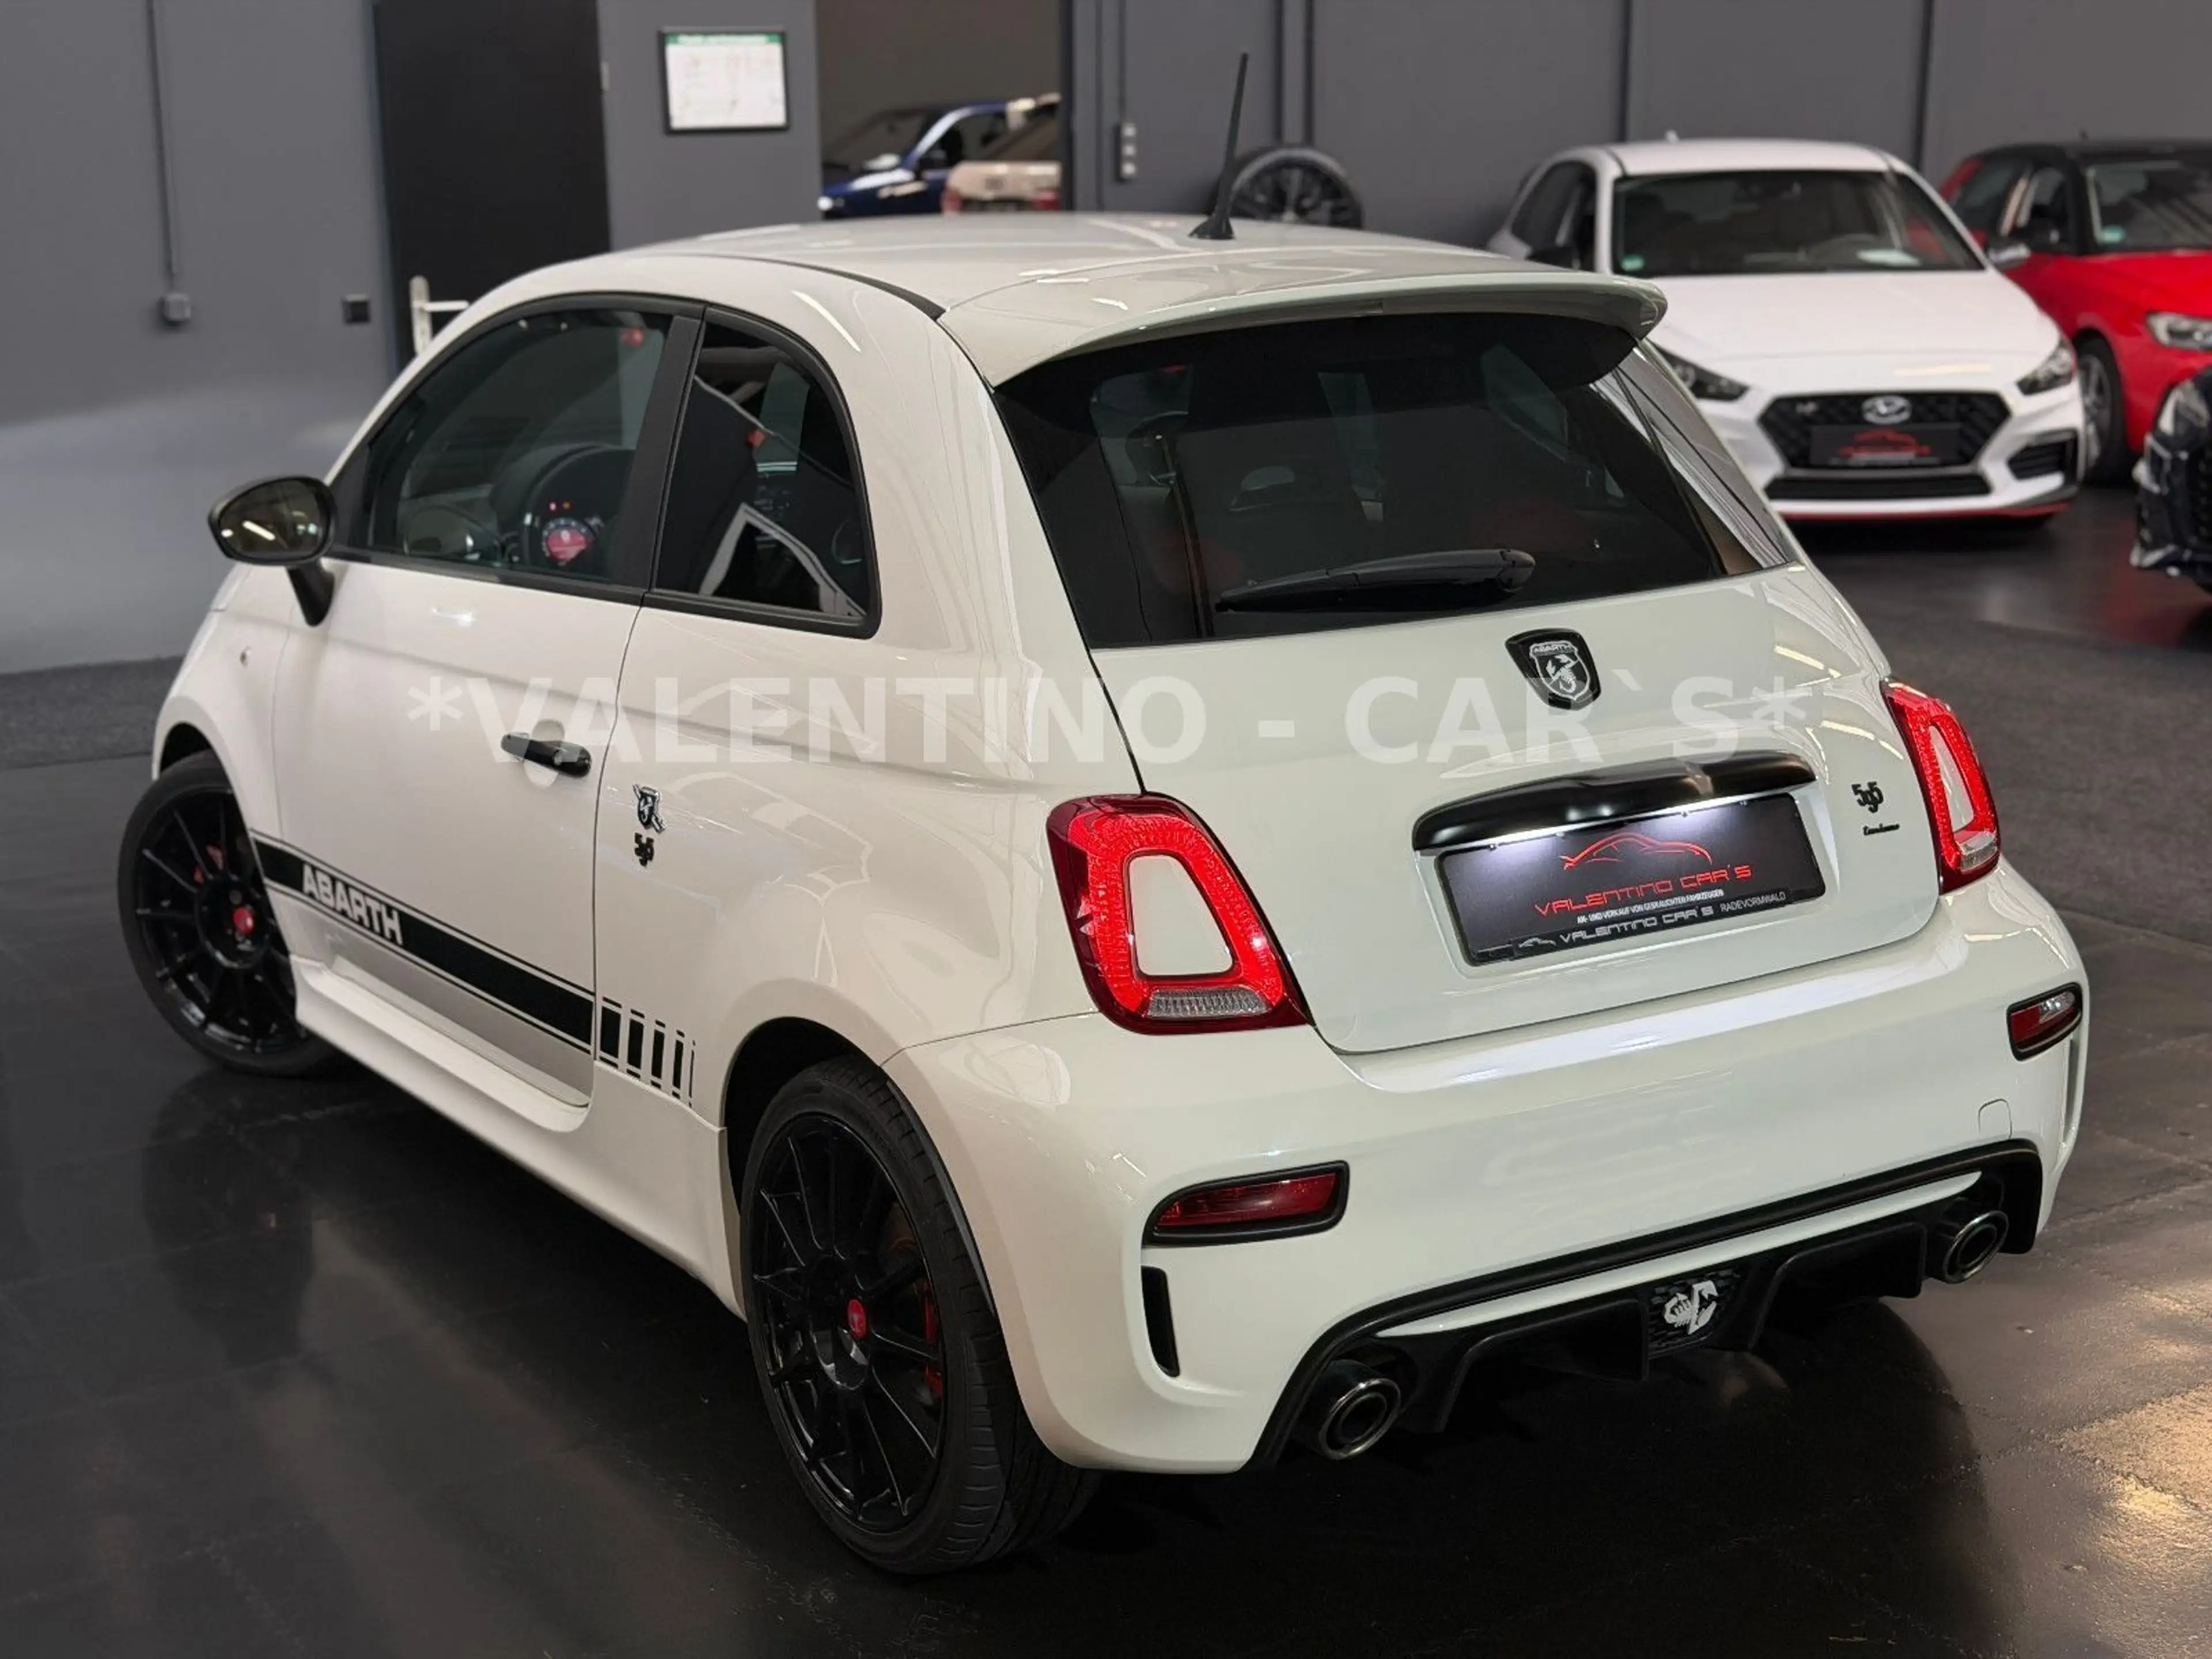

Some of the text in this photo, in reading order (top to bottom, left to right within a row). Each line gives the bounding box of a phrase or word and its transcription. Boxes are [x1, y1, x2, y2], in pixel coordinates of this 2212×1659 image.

[302, 863, 403, 945] ABARTH
[1534, 880, 1673, 917] VALENTINO
[1559, 916, 1658, 944] VALENTINO
